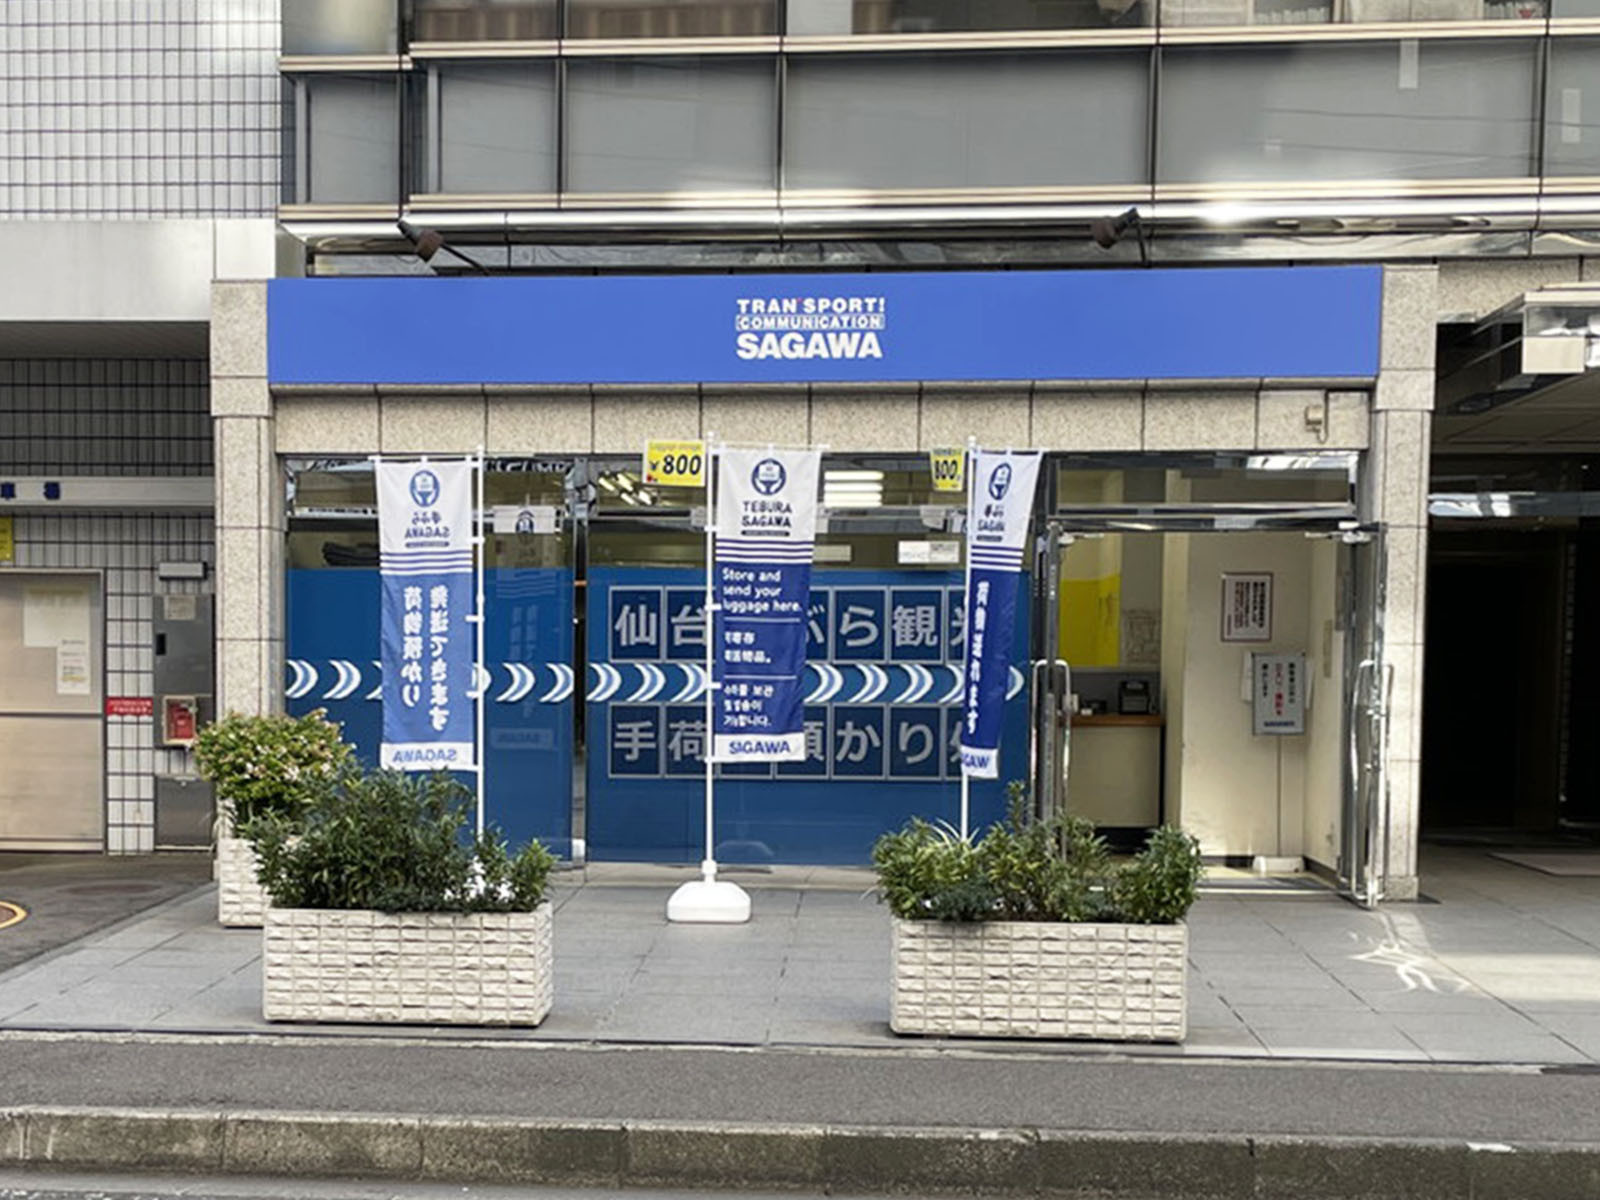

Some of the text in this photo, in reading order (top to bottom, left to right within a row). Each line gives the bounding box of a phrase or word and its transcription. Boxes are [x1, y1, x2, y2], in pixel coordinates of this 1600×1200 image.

[737, 315, 883, 330] COMMUNICATION
[736, 332, 883, 360] SAGAWA
[742, 500, 793, 514] TEBURA
[741, 515, 792, 529] SAGAWA
[722, 567, 781, 582] Store and
[722, 583, 782, 599] send your
